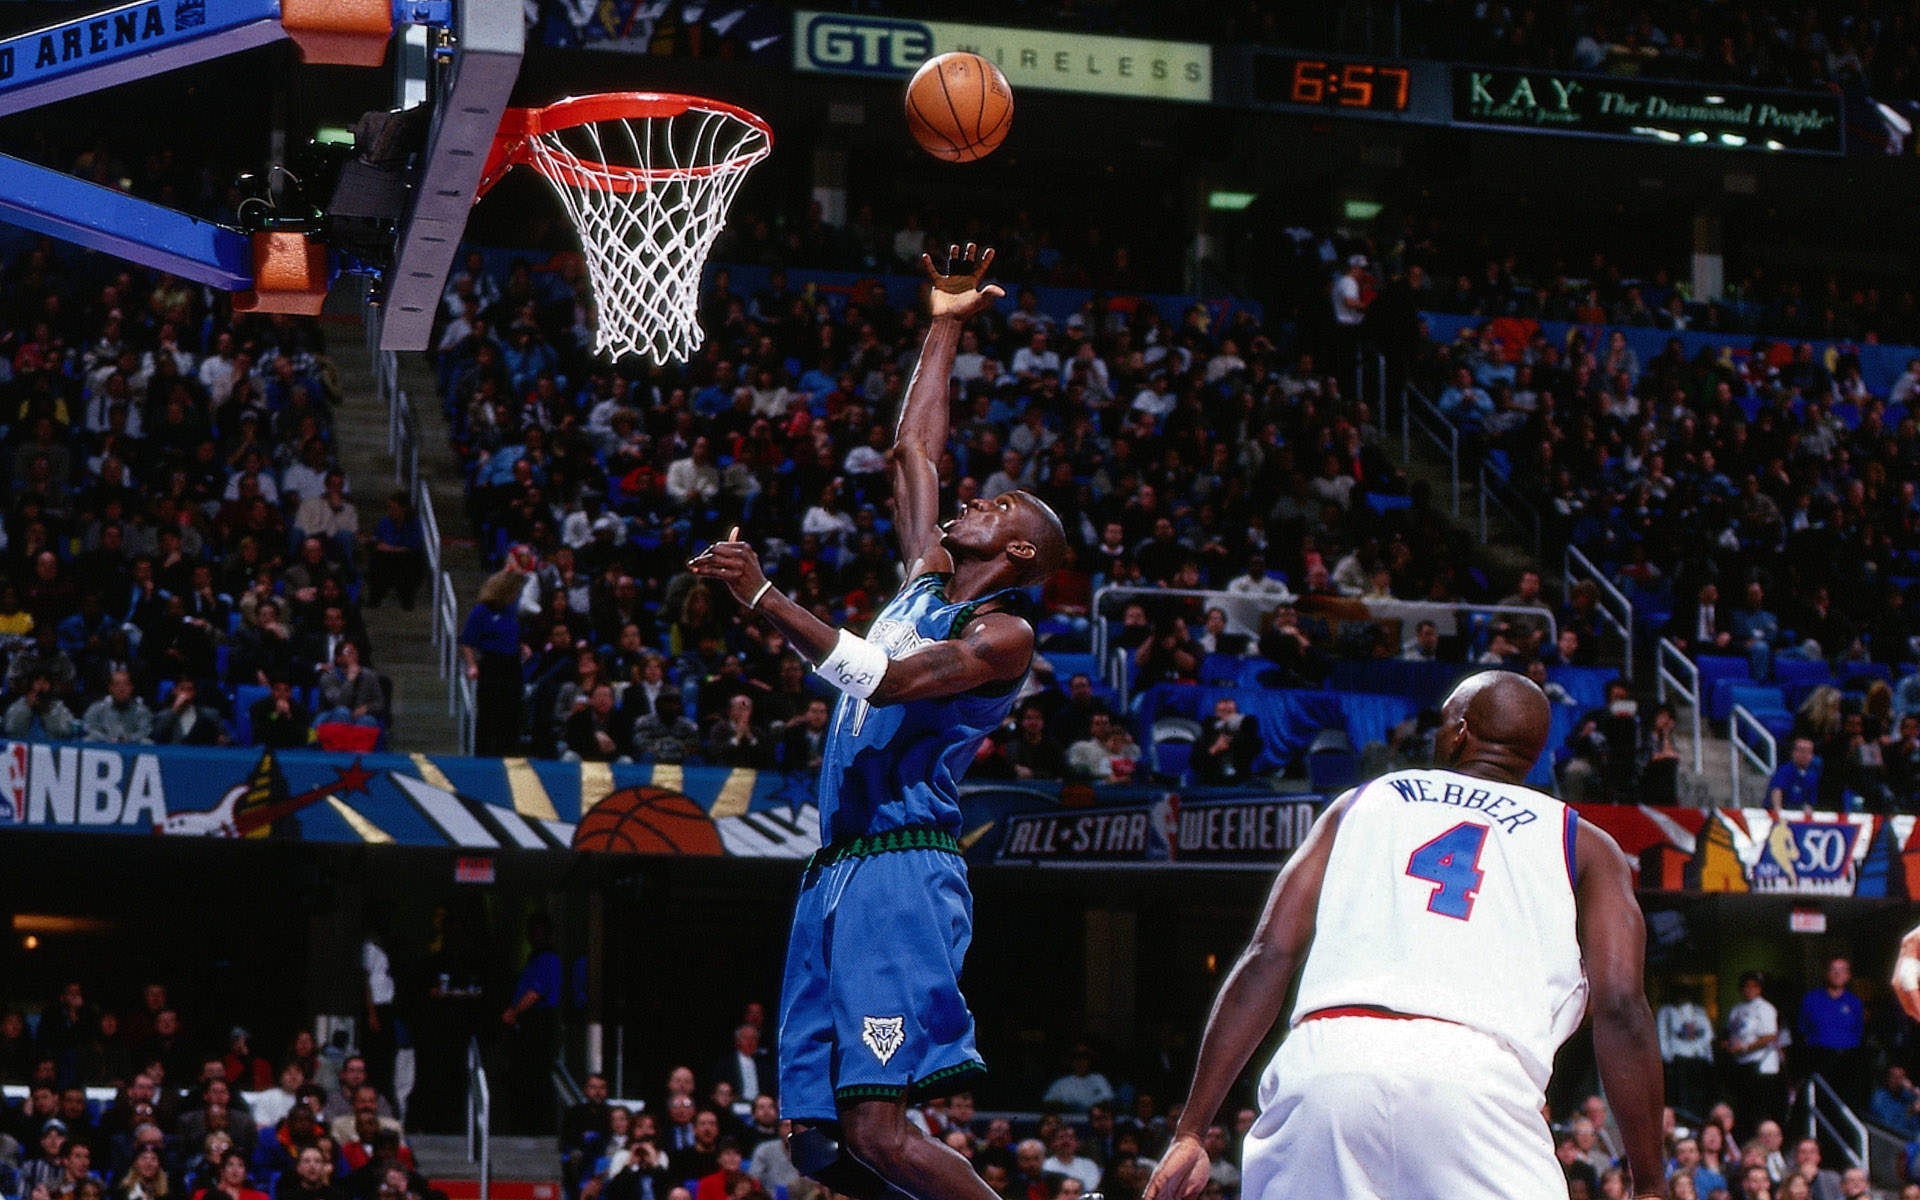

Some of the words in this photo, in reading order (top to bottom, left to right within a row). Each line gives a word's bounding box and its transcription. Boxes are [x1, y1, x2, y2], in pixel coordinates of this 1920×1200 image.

[35, 5, 165, 69] ARENA
[814, 24, 927, 69] GTE
[1292, 61, 1410, 111] 6:57
[1471, 72, 1577, 109] KAY
[1599, 92, 1641, 116] The
[856, 672, 874, 685] 21
[28, 743, 168, 826] NBA
[1387, 778, 1538, 834] WEBBER
[1178, 803, 1313, 850] WEEKEND
[1405, 820, 1490, 921] 4
[1797, 828, 1846, 873] 50
